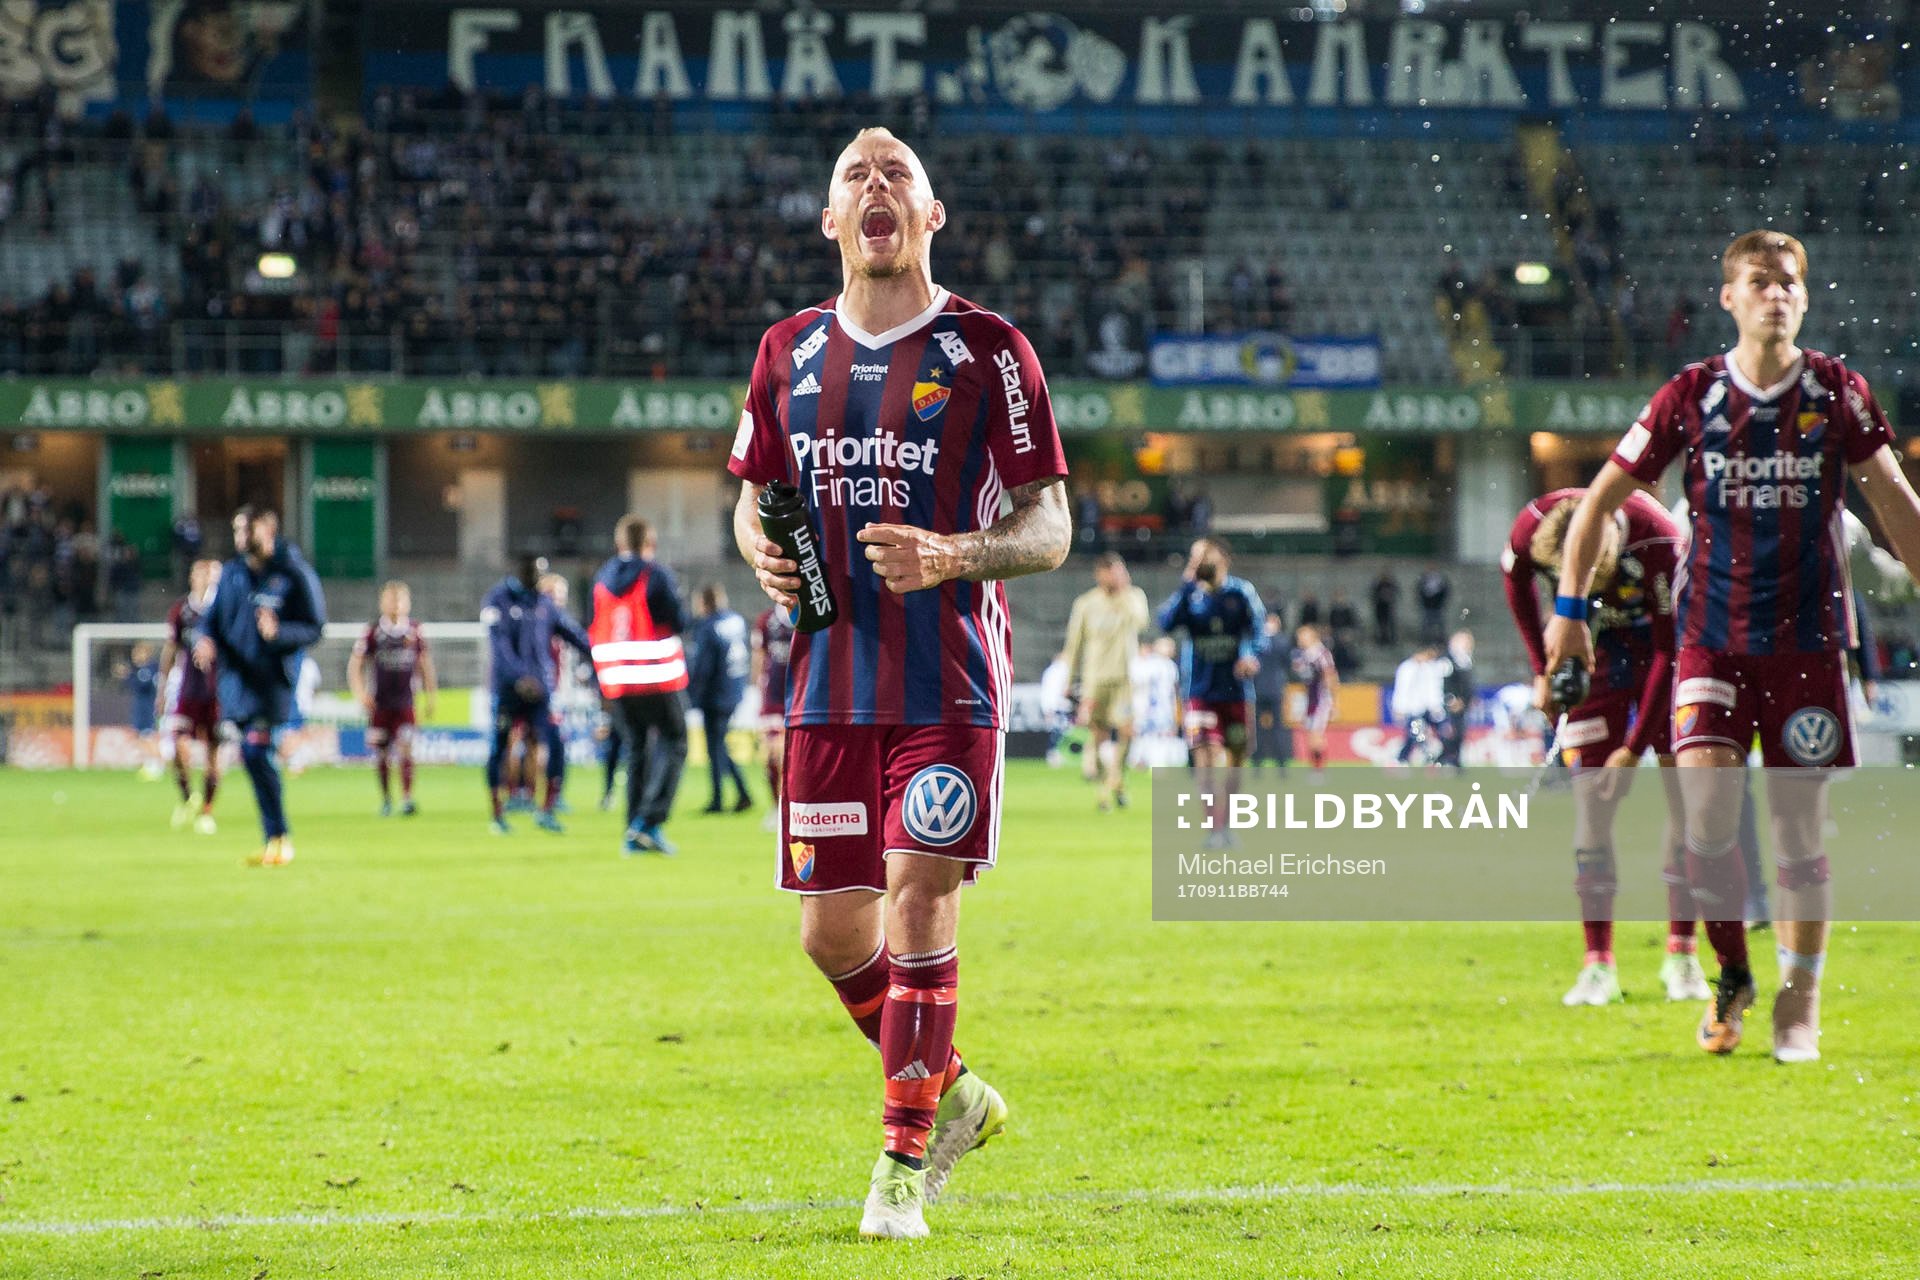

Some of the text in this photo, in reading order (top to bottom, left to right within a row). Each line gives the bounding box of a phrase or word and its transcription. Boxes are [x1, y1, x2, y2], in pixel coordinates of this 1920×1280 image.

[850, 363, 889, 374] Prioritet
[853, 372, 882, 381] Finans
[793, 385, 822, 396] adidas
[993, 349, 1031, 454] stadium
[790, 428, 939, 476] Prioritet
[1703, 450, 1824, 480] Prioritet
[811, 469, 910, 508] Finans
[1718, 479, 1808, 508] Finans
[793, 525, 831, 616] stadium
[793, 812, 860, 825] Moderna
